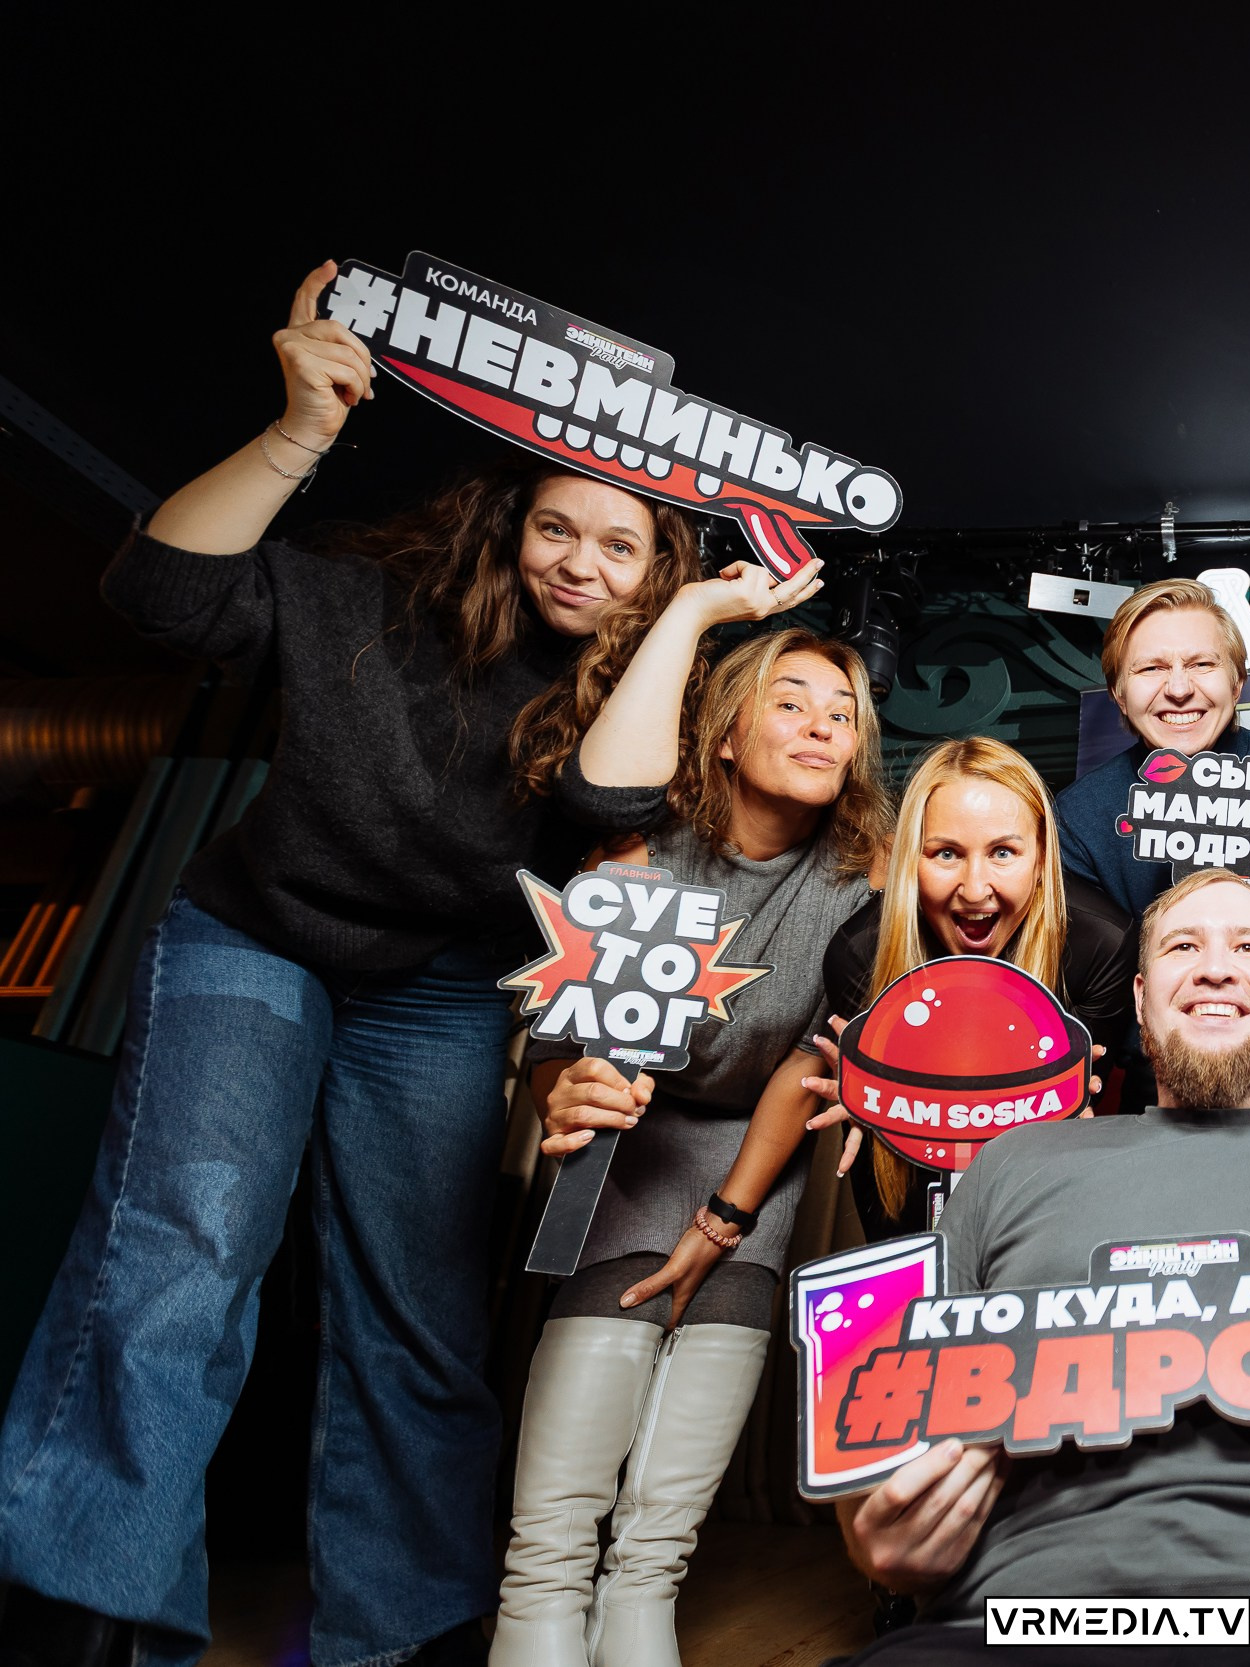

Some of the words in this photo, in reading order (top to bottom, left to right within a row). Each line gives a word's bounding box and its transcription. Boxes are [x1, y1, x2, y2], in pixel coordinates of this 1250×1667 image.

[425, 267, 538, 326] КОМАНДА
[565, 326, 655, 371] ЭЙНШТЕЙН
[589, 346, 627, 370] Party
[327, 267, 898, 526] #НЕВМИНЬКО
[609, 867, 662, 881] ГЛАВНЫЙ
[567, 877, 721, 941] СУЕ
[593, 931, 697, 993] ТО
[536, 985, 705, 1048] ЛОГ
[863, 1085, 881, 1114] I
[887, 1095, 941, 1128] AM
[947, 1088, 1063, 1129] SOSKA
[1148, 1261, 1203, 1278] Party
[908, 1292, 1026, 1341] КТО
[1035, 1280, 1218, 1331] КУДА,
